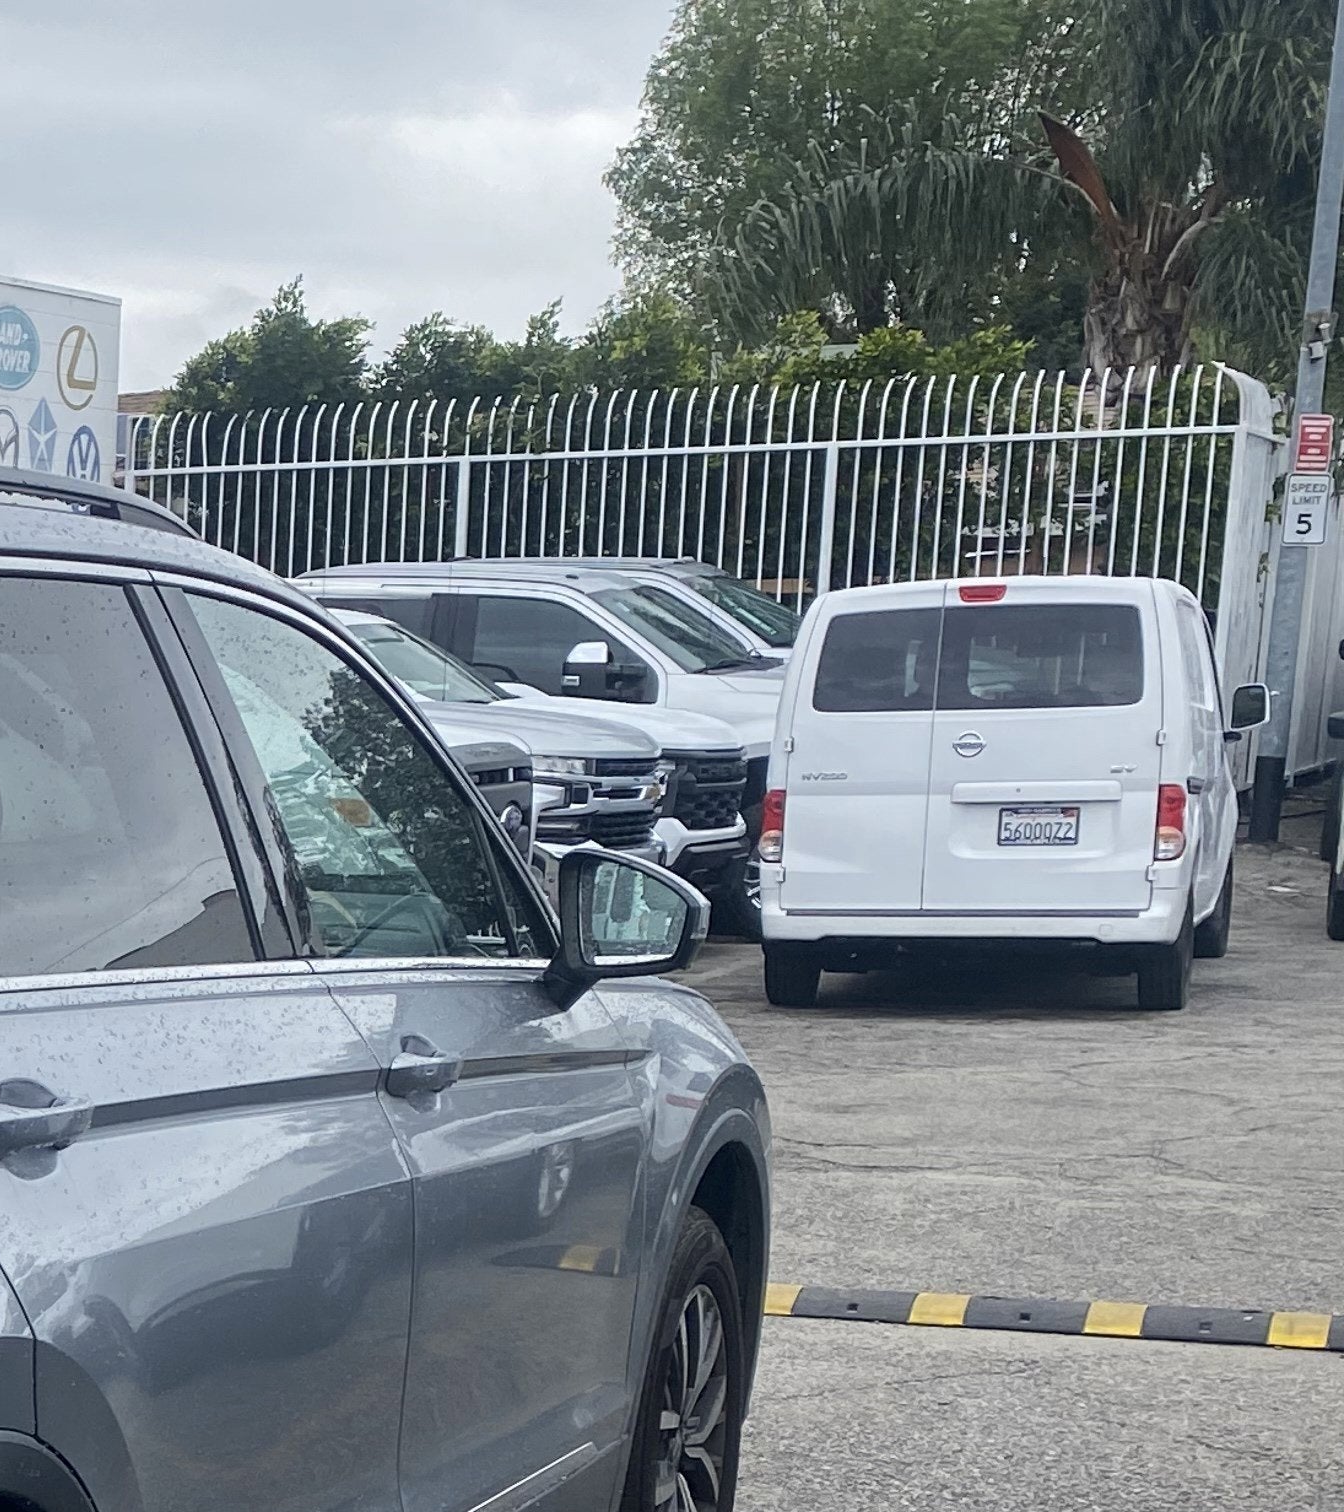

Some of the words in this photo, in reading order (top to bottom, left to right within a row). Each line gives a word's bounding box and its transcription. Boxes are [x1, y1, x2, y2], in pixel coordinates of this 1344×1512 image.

[1290, 483, 1328, 494] SPEED
[1292, 495, 1322, 506] LIMIT
[1295, 513, 1312, 536] 5
